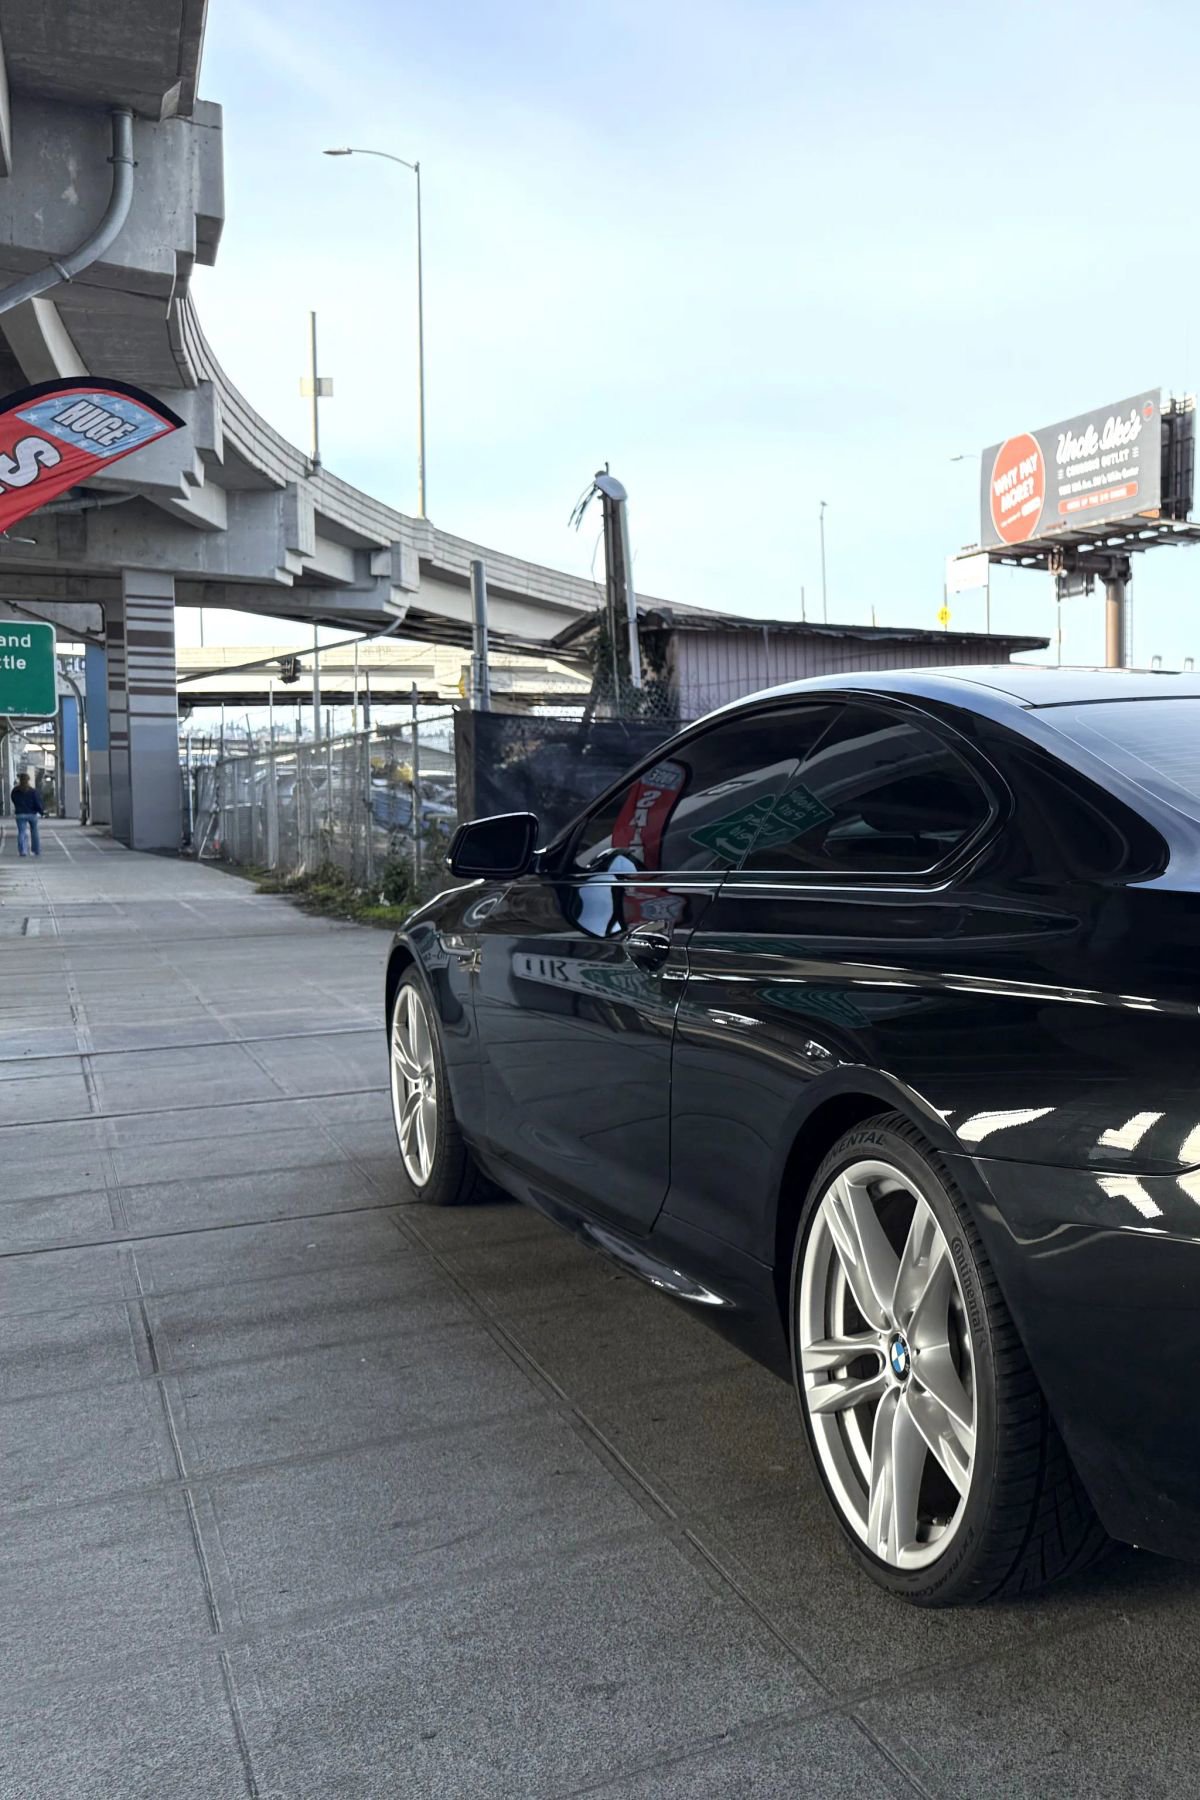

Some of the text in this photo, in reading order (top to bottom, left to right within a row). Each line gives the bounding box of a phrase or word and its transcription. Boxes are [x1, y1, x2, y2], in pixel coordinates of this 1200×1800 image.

[52, 399, 139, 447] HUGE
[0, 435, 62, 494] S
[993, 466, 1018, 497] WHY
[0, 655, 27, 670] tle
[952, 1237, 984, 1334] Continental
